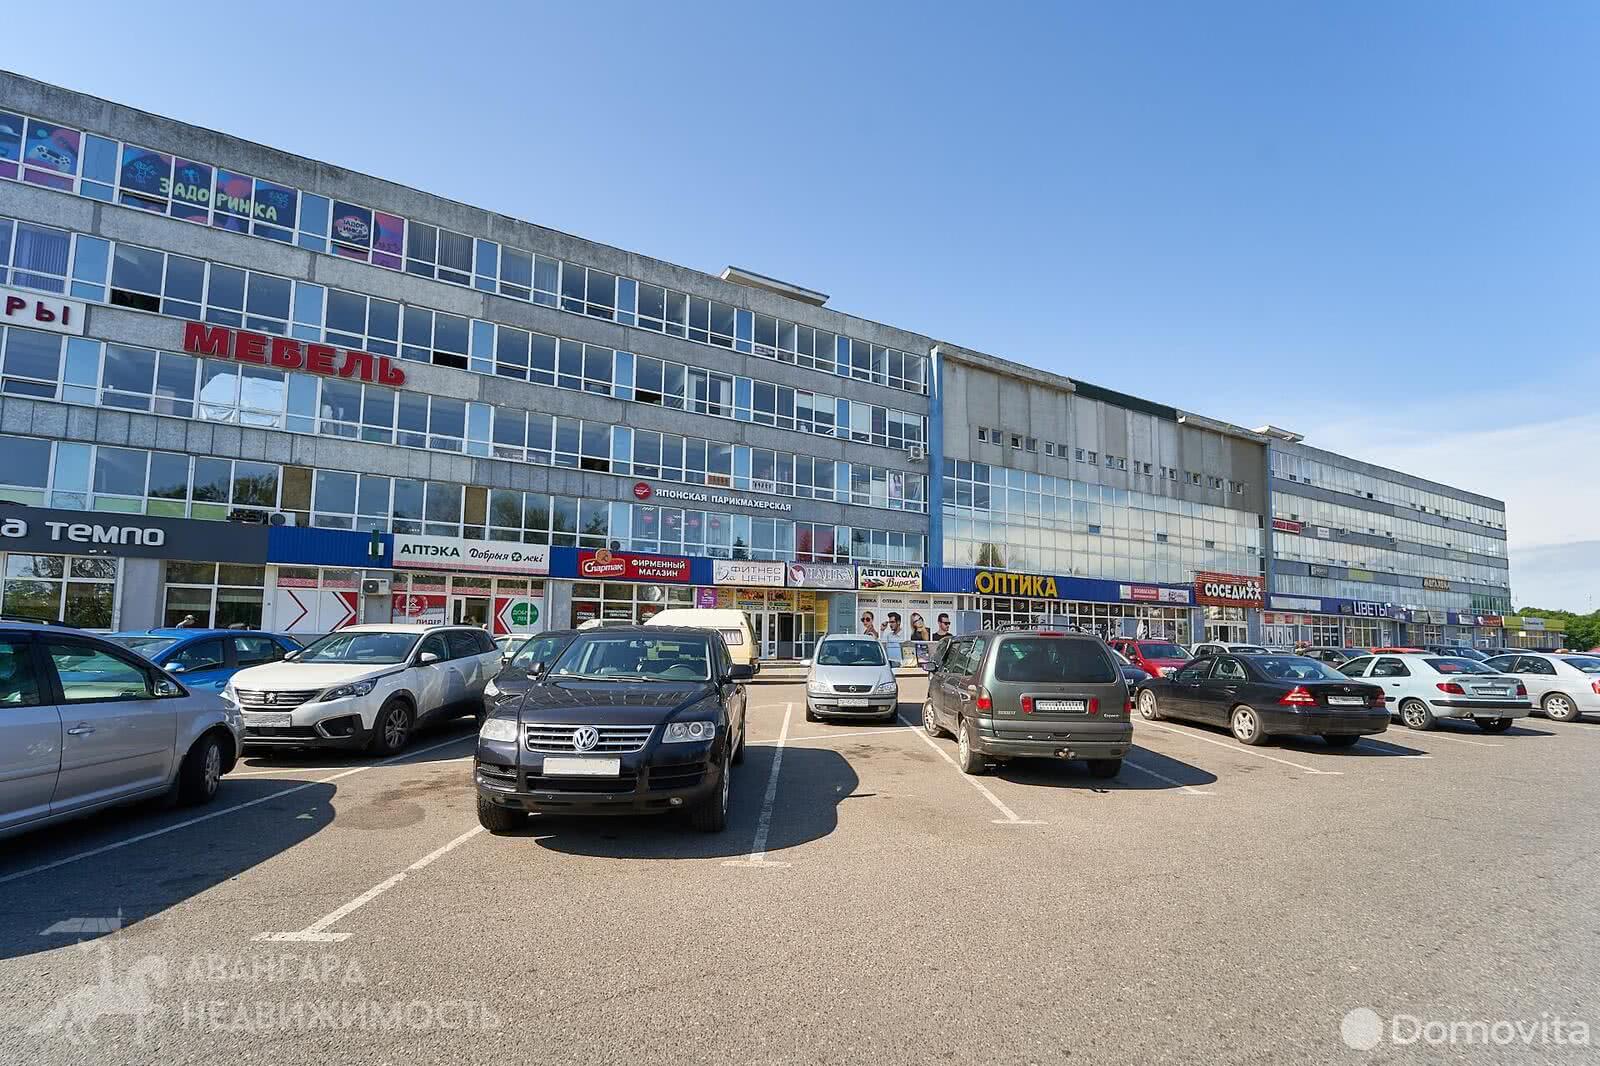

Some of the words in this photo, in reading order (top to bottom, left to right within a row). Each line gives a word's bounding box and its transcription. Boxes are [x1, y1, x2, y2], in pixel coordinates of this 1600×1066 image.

[159, 177, 278, 221] ЗАДОРИНКА
[183, 321, 407, 387] МЕБЕЛЬ
[655, 488, 708, 502] ЯПОНСКАЯ
[711, 495, 792, 511] ПАРИКМАХЕРСКАЯ
[45, 521, 165, 546] темпо
[400, 543, 461, 558] АПТЭКА
[469, 547, 509, 563] Добрыя
[584, 561, 624, 573] Спартак
[631, 559, 686, 569] ФИРМЕННЫЙ
[731, 566, 781, 575] ФИТНЕС
[638, 568, 678, 577] МАГАЗИН
[742, 574, 781, 583] ЦЕНТР
[861, 568, 920, 579] АВТОШКОЛА
[975, 571, 1058, 598] ОПТИКА
